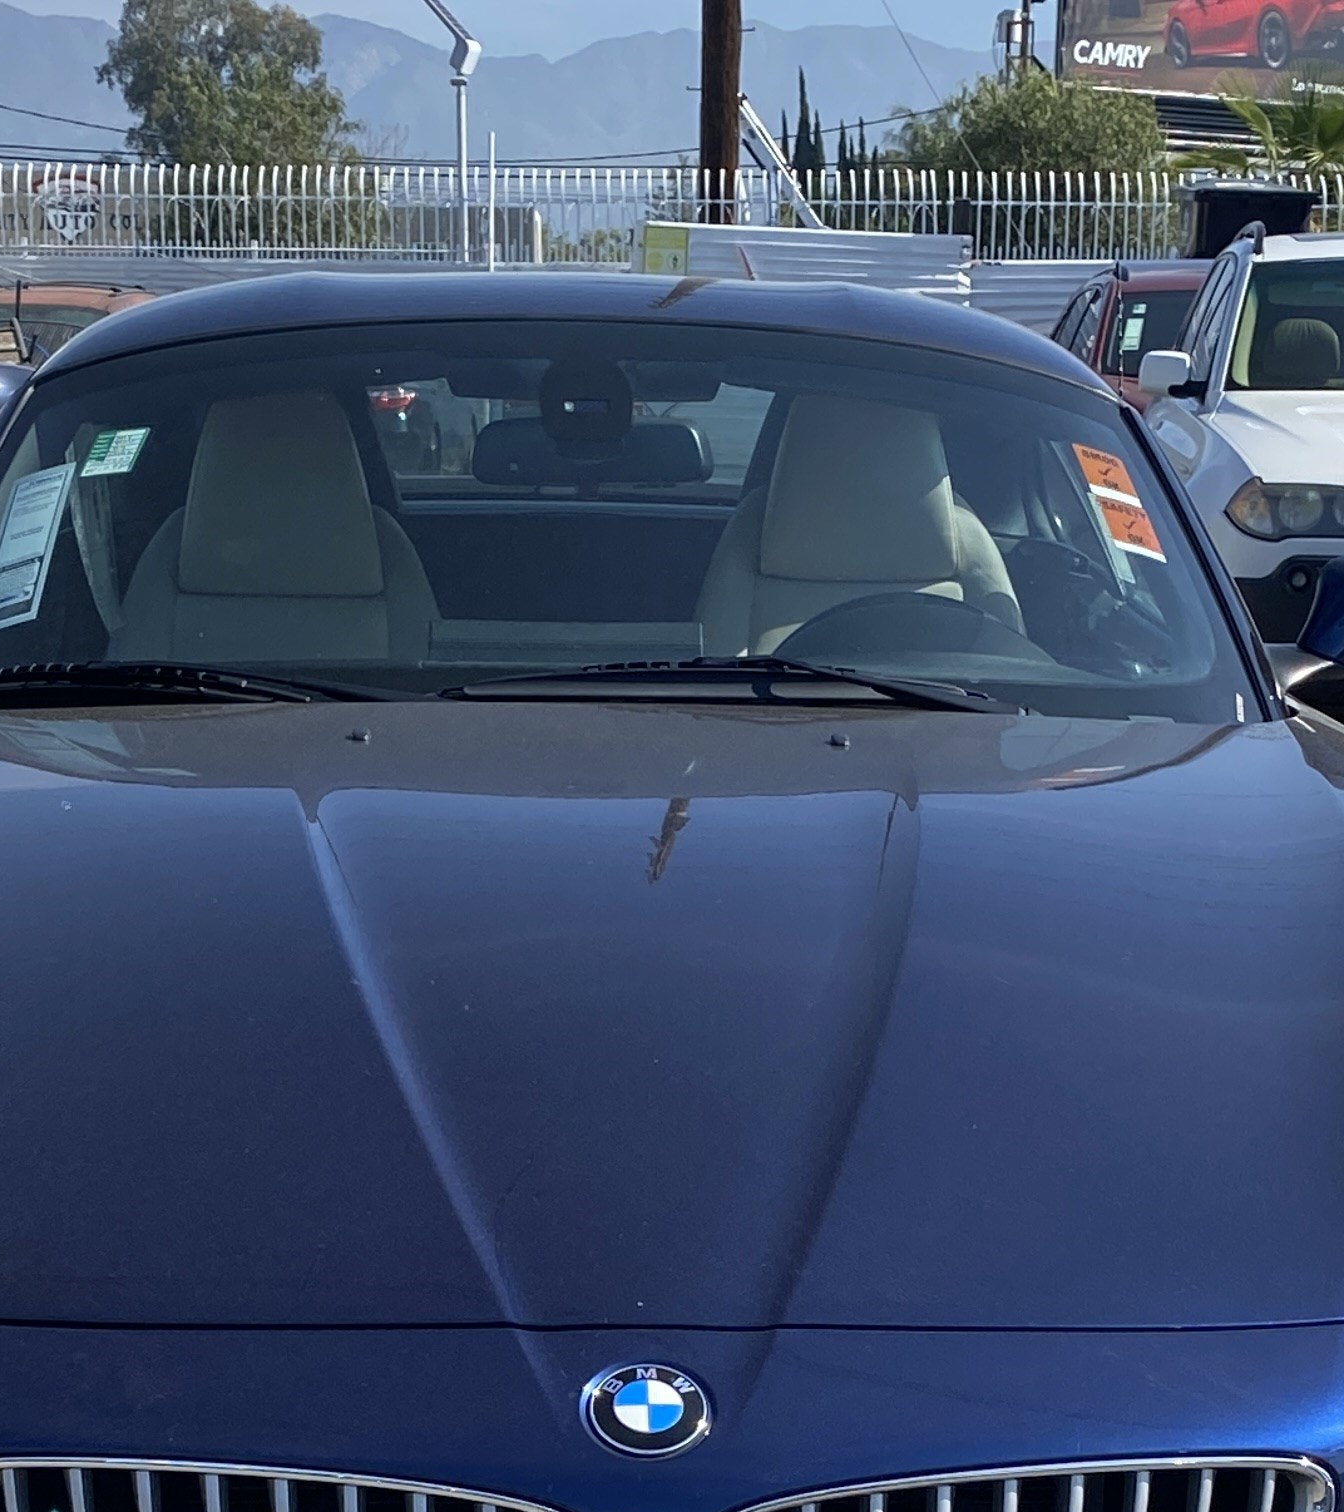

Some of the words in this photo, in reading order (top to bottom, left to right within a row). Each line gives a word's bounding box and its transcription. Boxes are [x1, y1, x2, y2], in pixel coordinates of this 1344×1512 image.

[1074, 39, 1151, 69] CAMRY
[39, 213, 96, 231] AUTO
[601, 1367, 696, 1395] BMW
